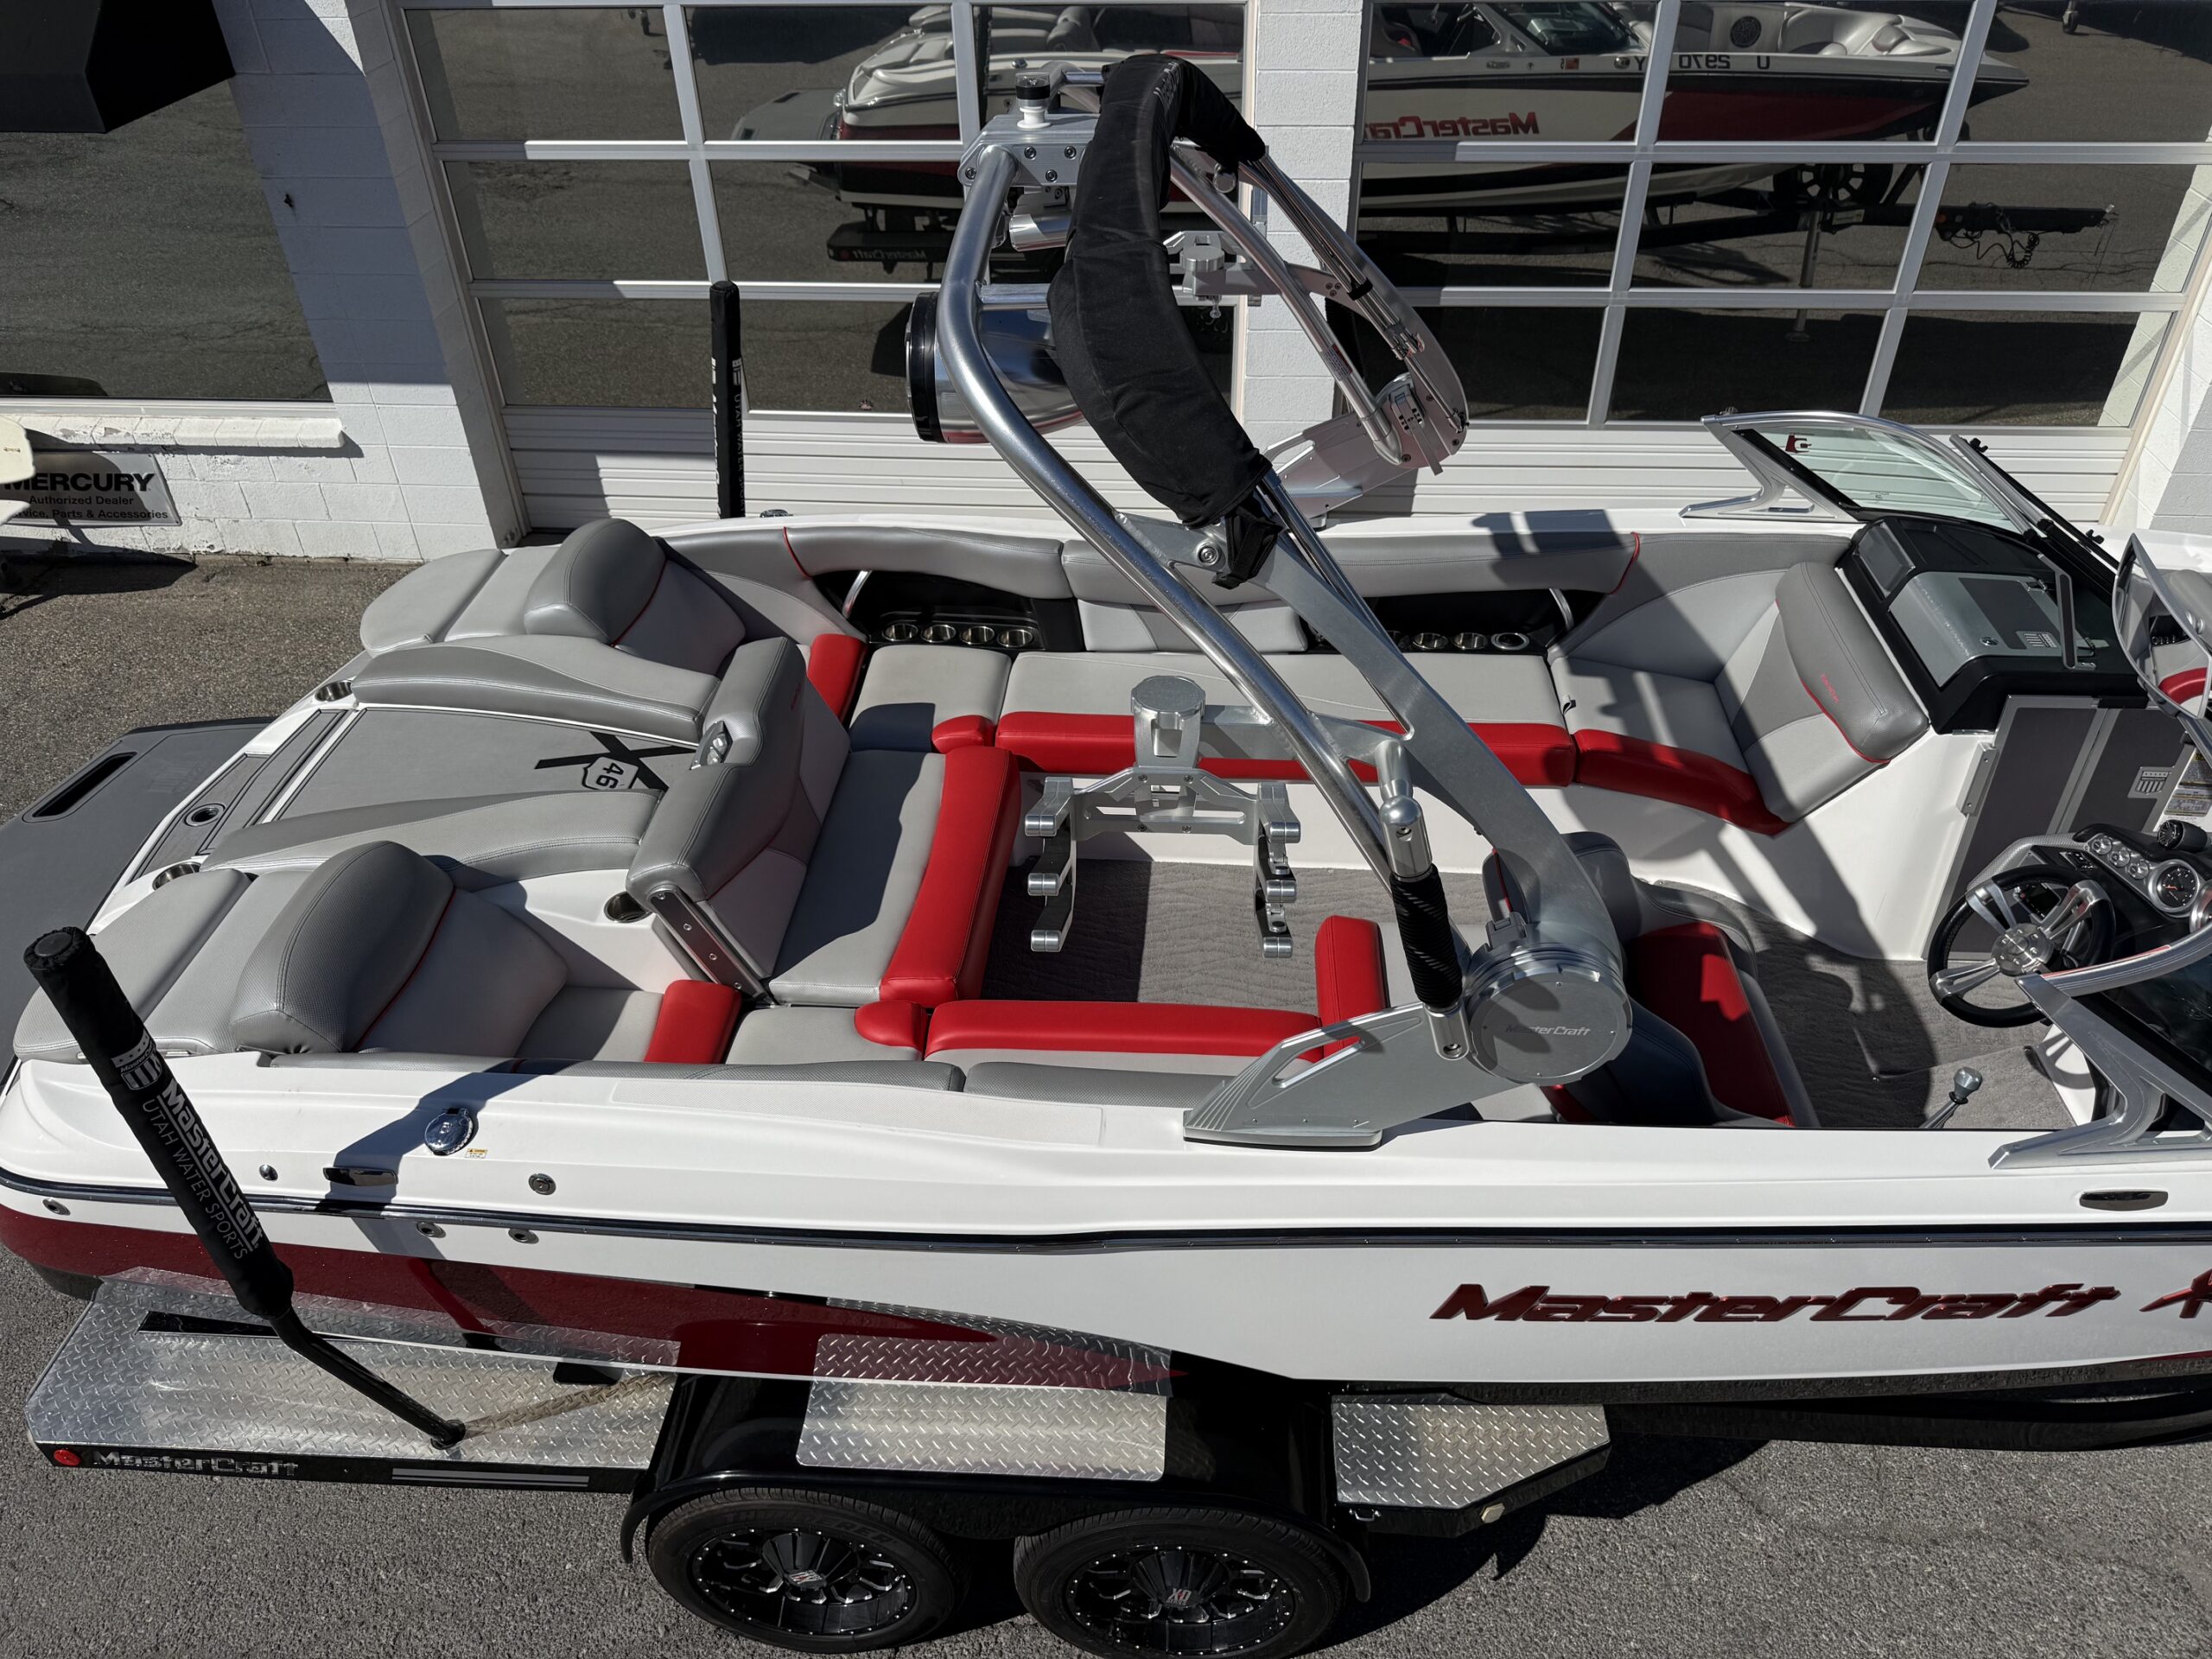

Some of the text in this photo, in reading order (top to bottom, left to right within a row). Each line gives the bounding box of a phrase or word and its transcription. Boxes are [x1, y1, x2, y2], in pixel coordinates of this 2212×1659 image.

[29, 494, 134, 505] Authorized Dealer
[52, 509, 83, 519] Parts
[87, 509, 94, 518] &
[98, 509, 168, 519] Accessories
[595, 761, 624, 790] 46
[162, 1078, 263, 1246] MasterCraft
[143, 1099, 248, 1259] UTAH WATER SPORTS
[1430, 1283, 2122, 1322] MasterCraft
[92, 1450, 299, 1477] MasterCraft
